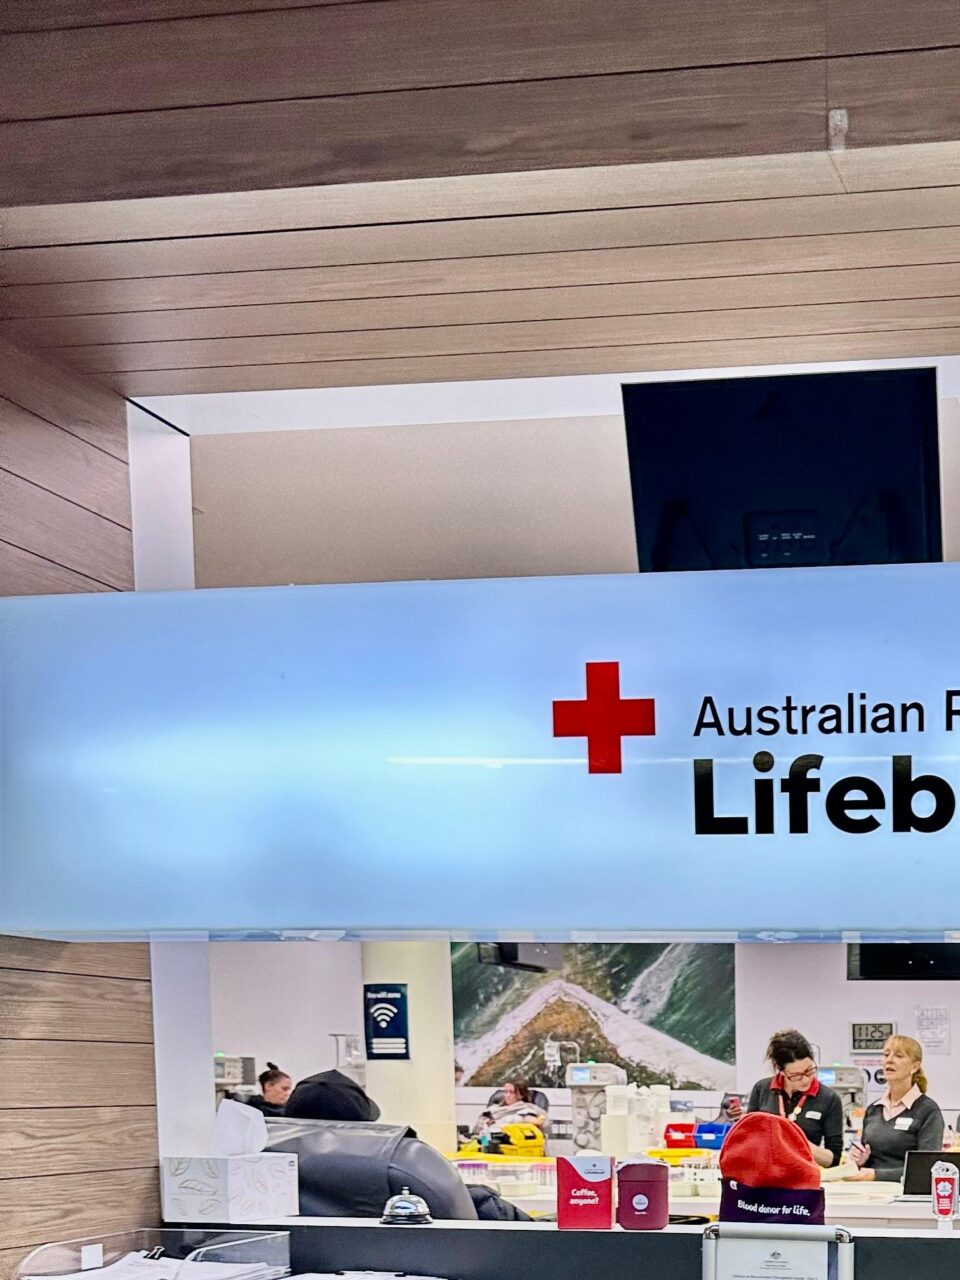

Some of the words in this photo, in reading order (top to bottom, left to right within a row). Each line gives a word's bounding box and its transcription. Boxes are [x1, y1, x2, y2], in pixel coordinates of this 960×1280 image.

[692, 693, 926, 738] Australian
[571, 1188, 598, 1197] Coffee,
[569, 1197, 600, 1206] anyone?
[737, 1199, 758, 1213] Blood
[758, 1203, 781, 1215] donor
[781, 1205, 793, 1215] for
